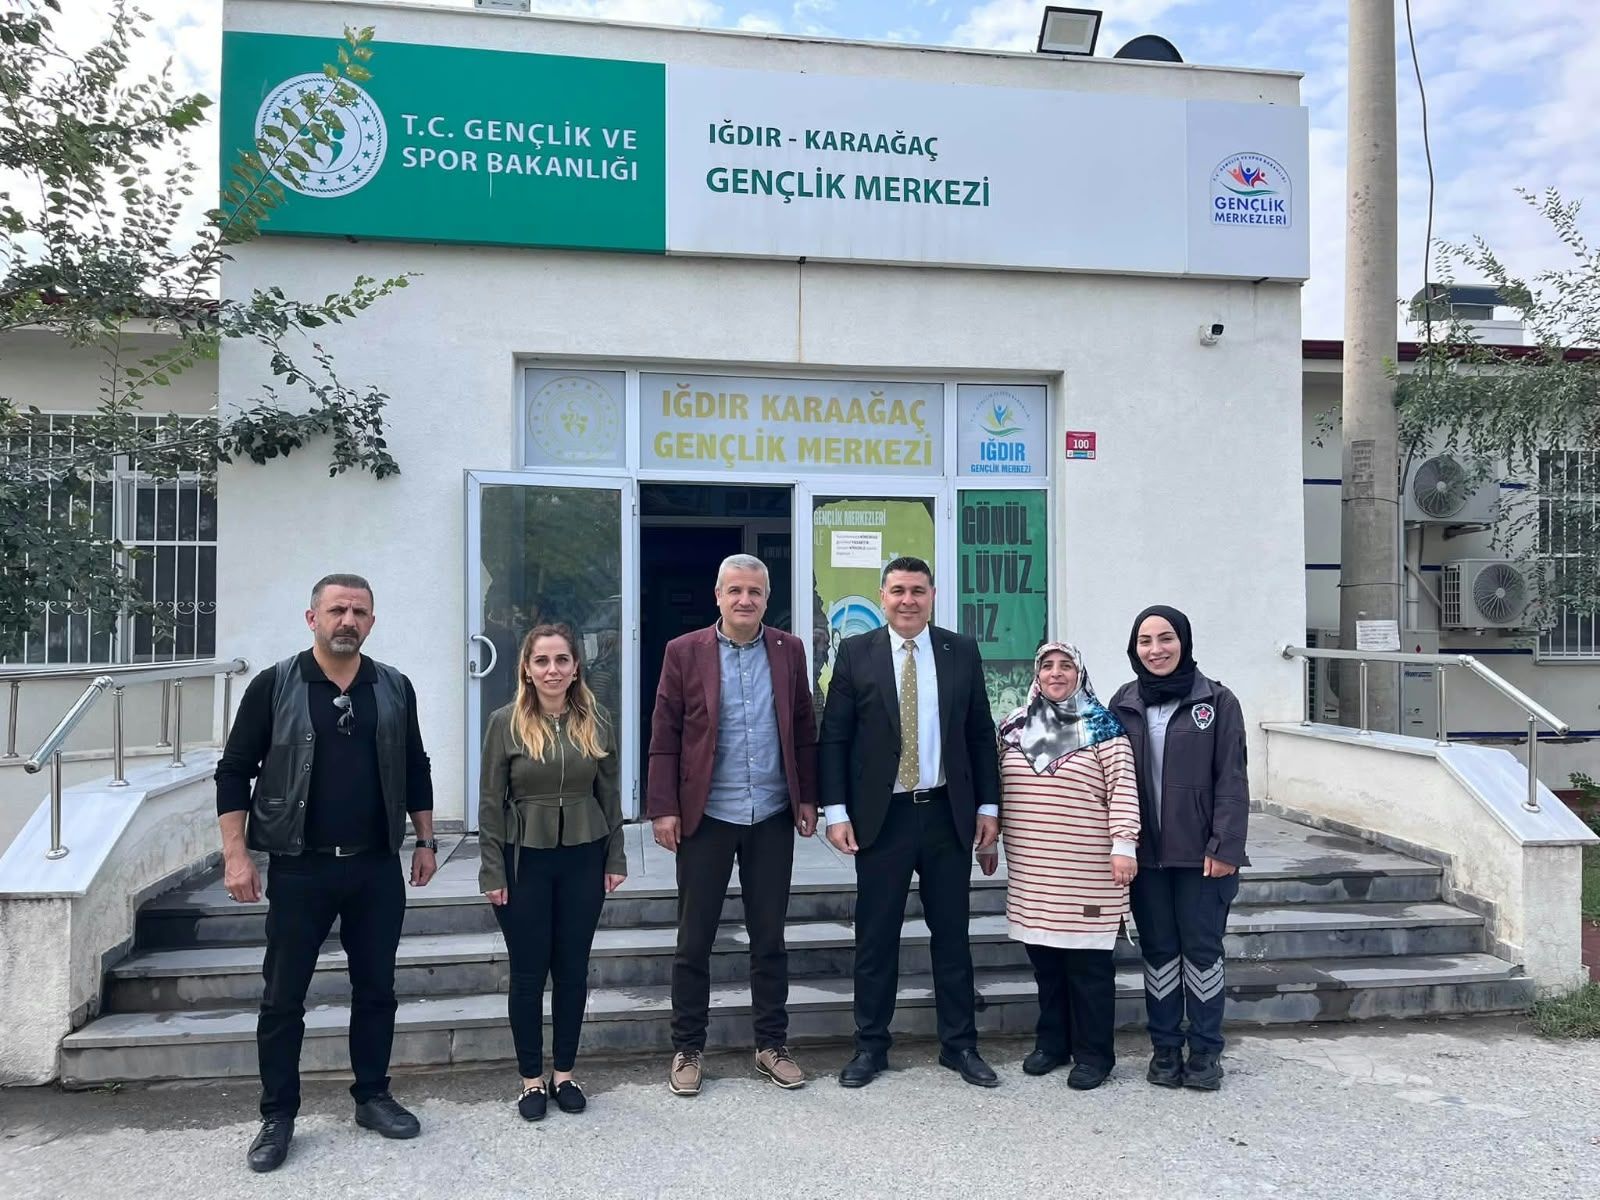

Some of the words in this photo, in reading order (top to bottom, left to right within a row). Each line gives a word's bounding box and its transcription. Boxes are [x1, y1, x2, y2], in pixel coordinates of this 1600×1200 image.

[401, 113, 454, 139] T.C.
[464, 119, 592, 150] GENÇLİK
[602, 127, 637, 150] VE
[708, 118, 782, 148] IĞDIR
[804, 129, 939, 162] KARAAĞAÇ
[402, 146, 478, 172] SPOR
[487, 152, 638, 182] BAKANLIĞI
[706, 166, 846, 204] GENÇLİK
[854, 175, 990, 207] MERKEZİ
[1214, 196, 1285, 212] GENÇLİK
[1214, 212, 1287, 225] MERKEZLERİ
[661, 382, 749, 420] IĞDIR
[761, 390, 927, 434] KARAAĞAÇ
[653, 427, 787, 469] GENÇLİK
[797, 433, 933, 466] MERKEZİ
[980, 438, 1026, 461] IĞDIR
[1073, 439, 1089, 449] 100
[961, 501, 1033, 546] GÖNÜL
